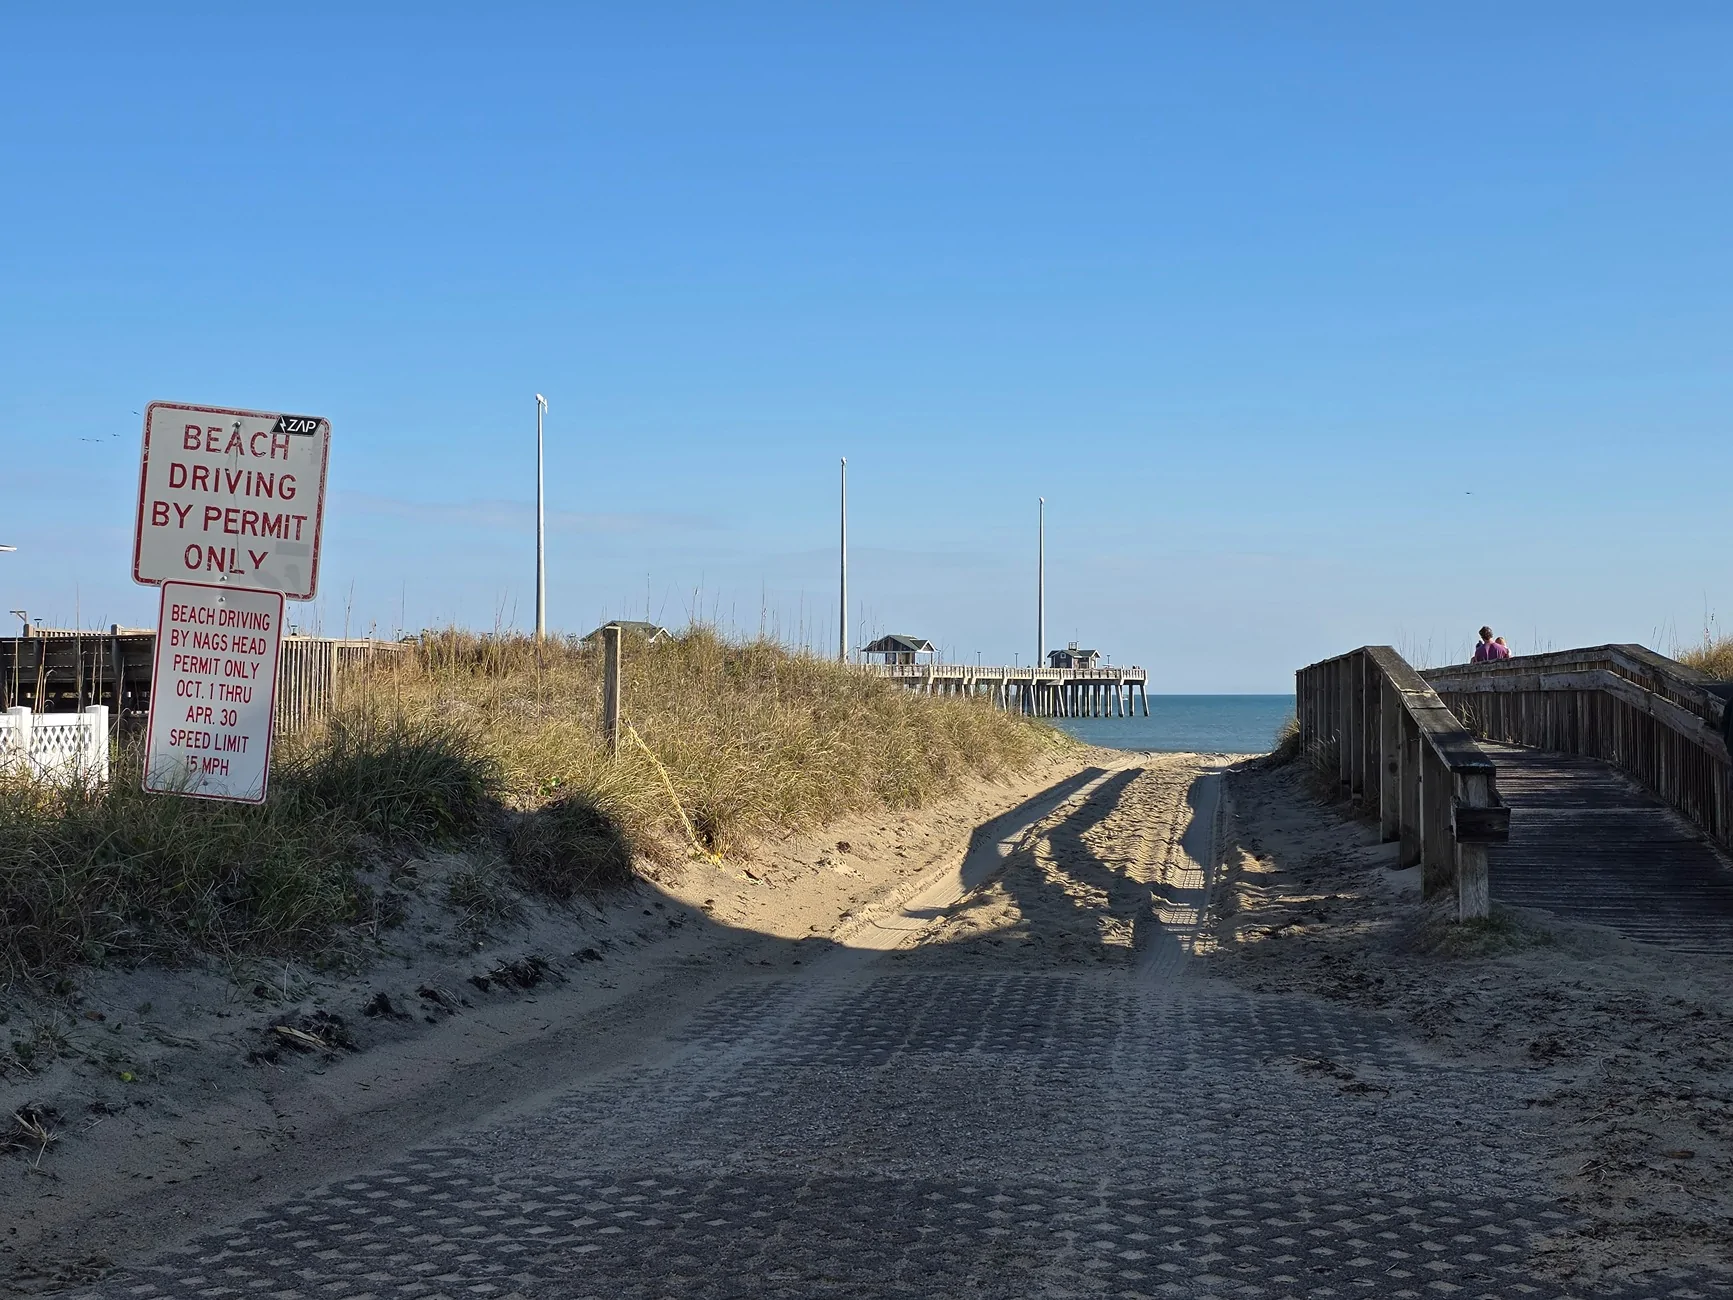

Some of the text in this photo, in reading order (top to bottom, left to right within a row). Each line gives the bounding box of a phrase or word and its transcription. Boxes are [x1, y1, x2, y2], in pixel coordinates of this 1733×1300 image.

[286, 419, 316, 432] ZAP
[183, 424, 290, 460] BEACH
[168, 463, 296, 500] DRIVING
[151, 500, 308, 541] BY PERMIT
[184, 544, 269, 575] ONLY
[171, 604, 271, 631] BEACH DRIVING
[171, 629, 267, 655] BY NAGS HEAD
[173, 654, 260, 680] PERMIT ONLY
[176, 679, 252, 704] OCT. 1 THRU
[185, 705, 237, 727] APR. 30
[169, 728, 249, 753] SPEED LIMIT
[185, 755, 230, 776] 15 MPH
